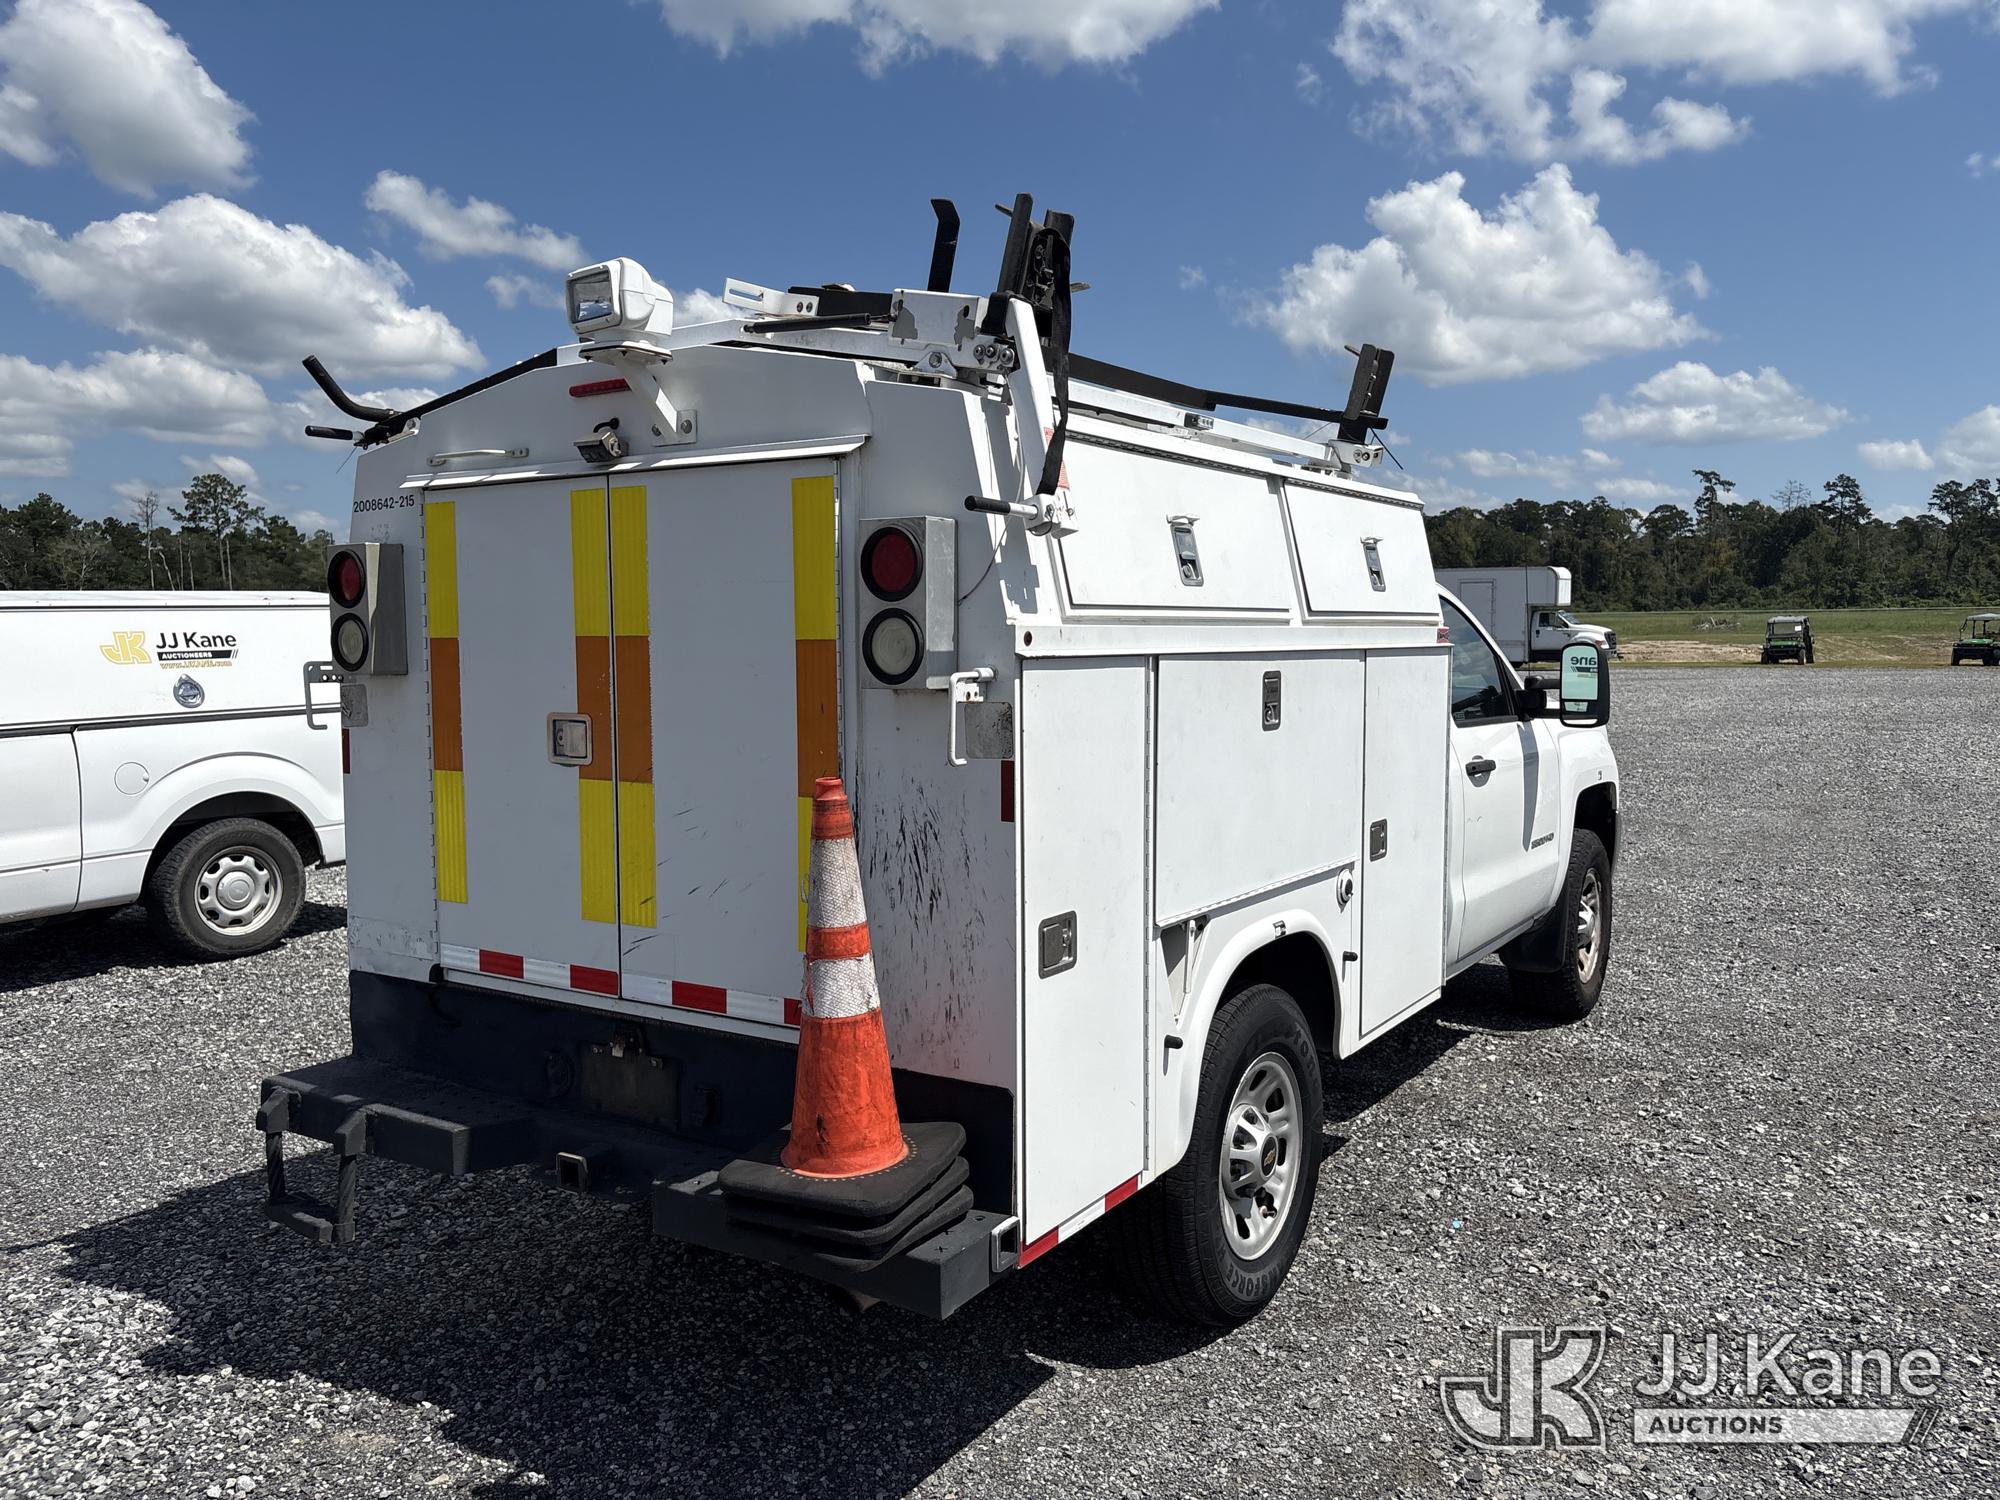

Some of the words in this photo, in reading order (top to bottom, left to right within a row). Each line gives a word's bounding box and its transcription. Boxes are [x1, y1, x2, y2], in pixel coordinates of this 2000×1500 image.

[353, 494, 415, 513] 2008642-215
[156, 632, 179, 649] JJ
[182, 631, 237, 648] Kane
[161, 651, 213, 661] AUCTIONEERS
